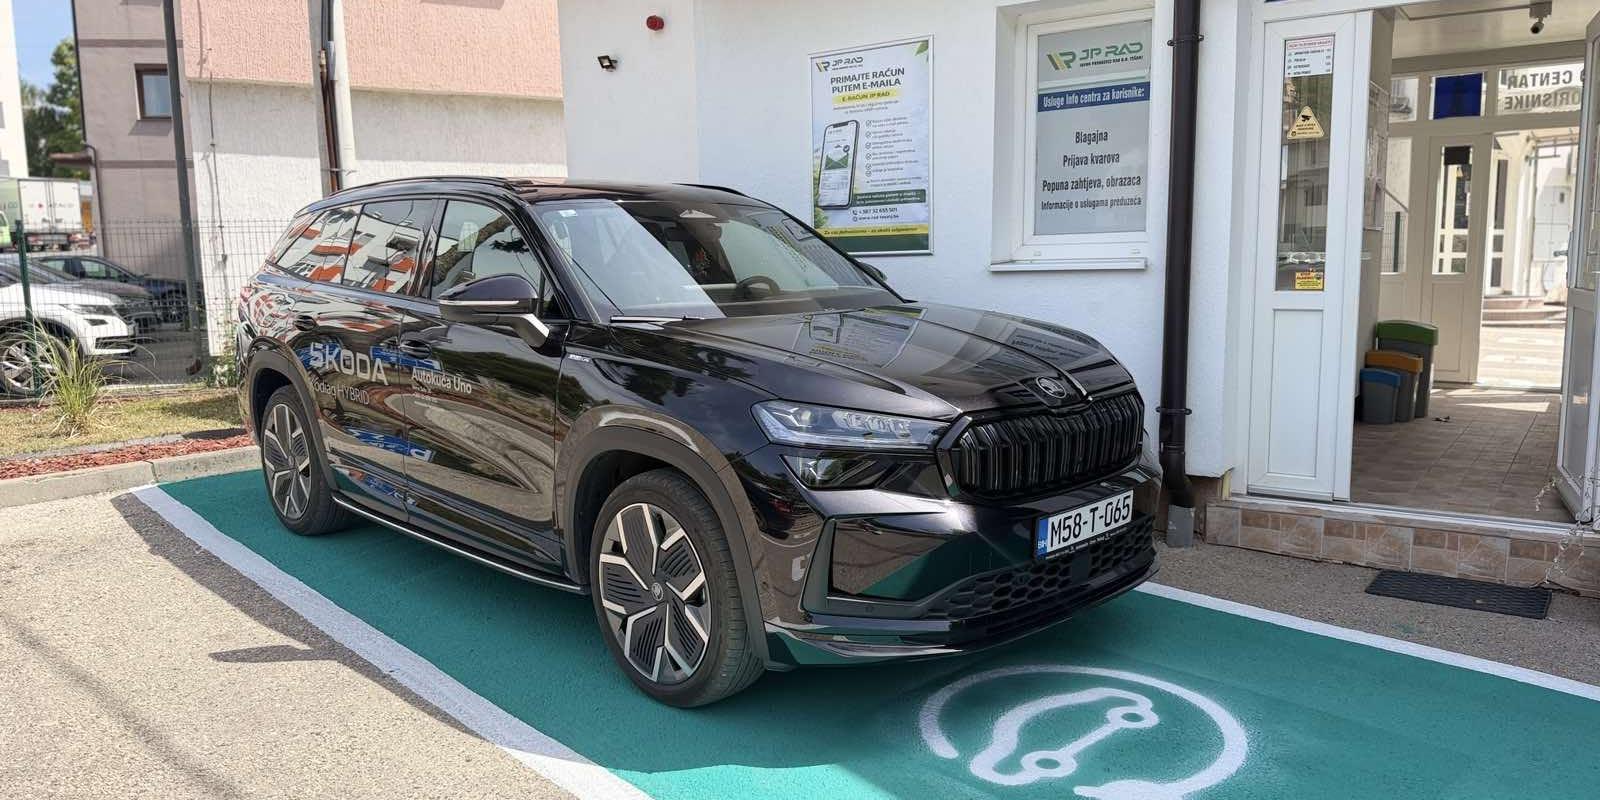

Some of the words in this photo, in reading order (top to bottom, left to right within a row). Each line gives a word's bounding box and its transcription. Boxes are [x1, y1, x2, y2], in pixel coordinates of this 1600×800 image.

[1079, 47, 1102, 61] JP
[1105, 41, 1144, 57] RAD
[830, 72, 870, 85] PRIMAJTE
[871, 67, 905, 80] RAČUN
[832, 82, 861, 94] PUTEM
[862, 78, 902, 90] E-MAILA
[1043, 95, 1065, 109] Usluge
[1065, 93, 1079, 105] Info
[1080, 91, 1101, 104] centra
[1102, 91, 1110, 101] za
[1111, 87, 1145, 101] korisnike:
[1075, 130, 1109, 145] Blagajna
[1063, 154, 1089, 168] Prijava
[1090, 152, 1120, 165] kvarova
[1042, 179, 1069, 194] Popuna
[1070, 176, 1104, 192] zahtjeva,
[1105, 175, 1141, 188] obrazaca
[1041, 199, 1073, 211] Informacije
[1080, 198, 1109, 210] uslugama
[411, 366, 452, 389] Autokuća
[453, 376, 473, 395] Uno
[337, 383, 370, 405] HYBRID
[1050, 494, 1132, 548] M58-T-065
